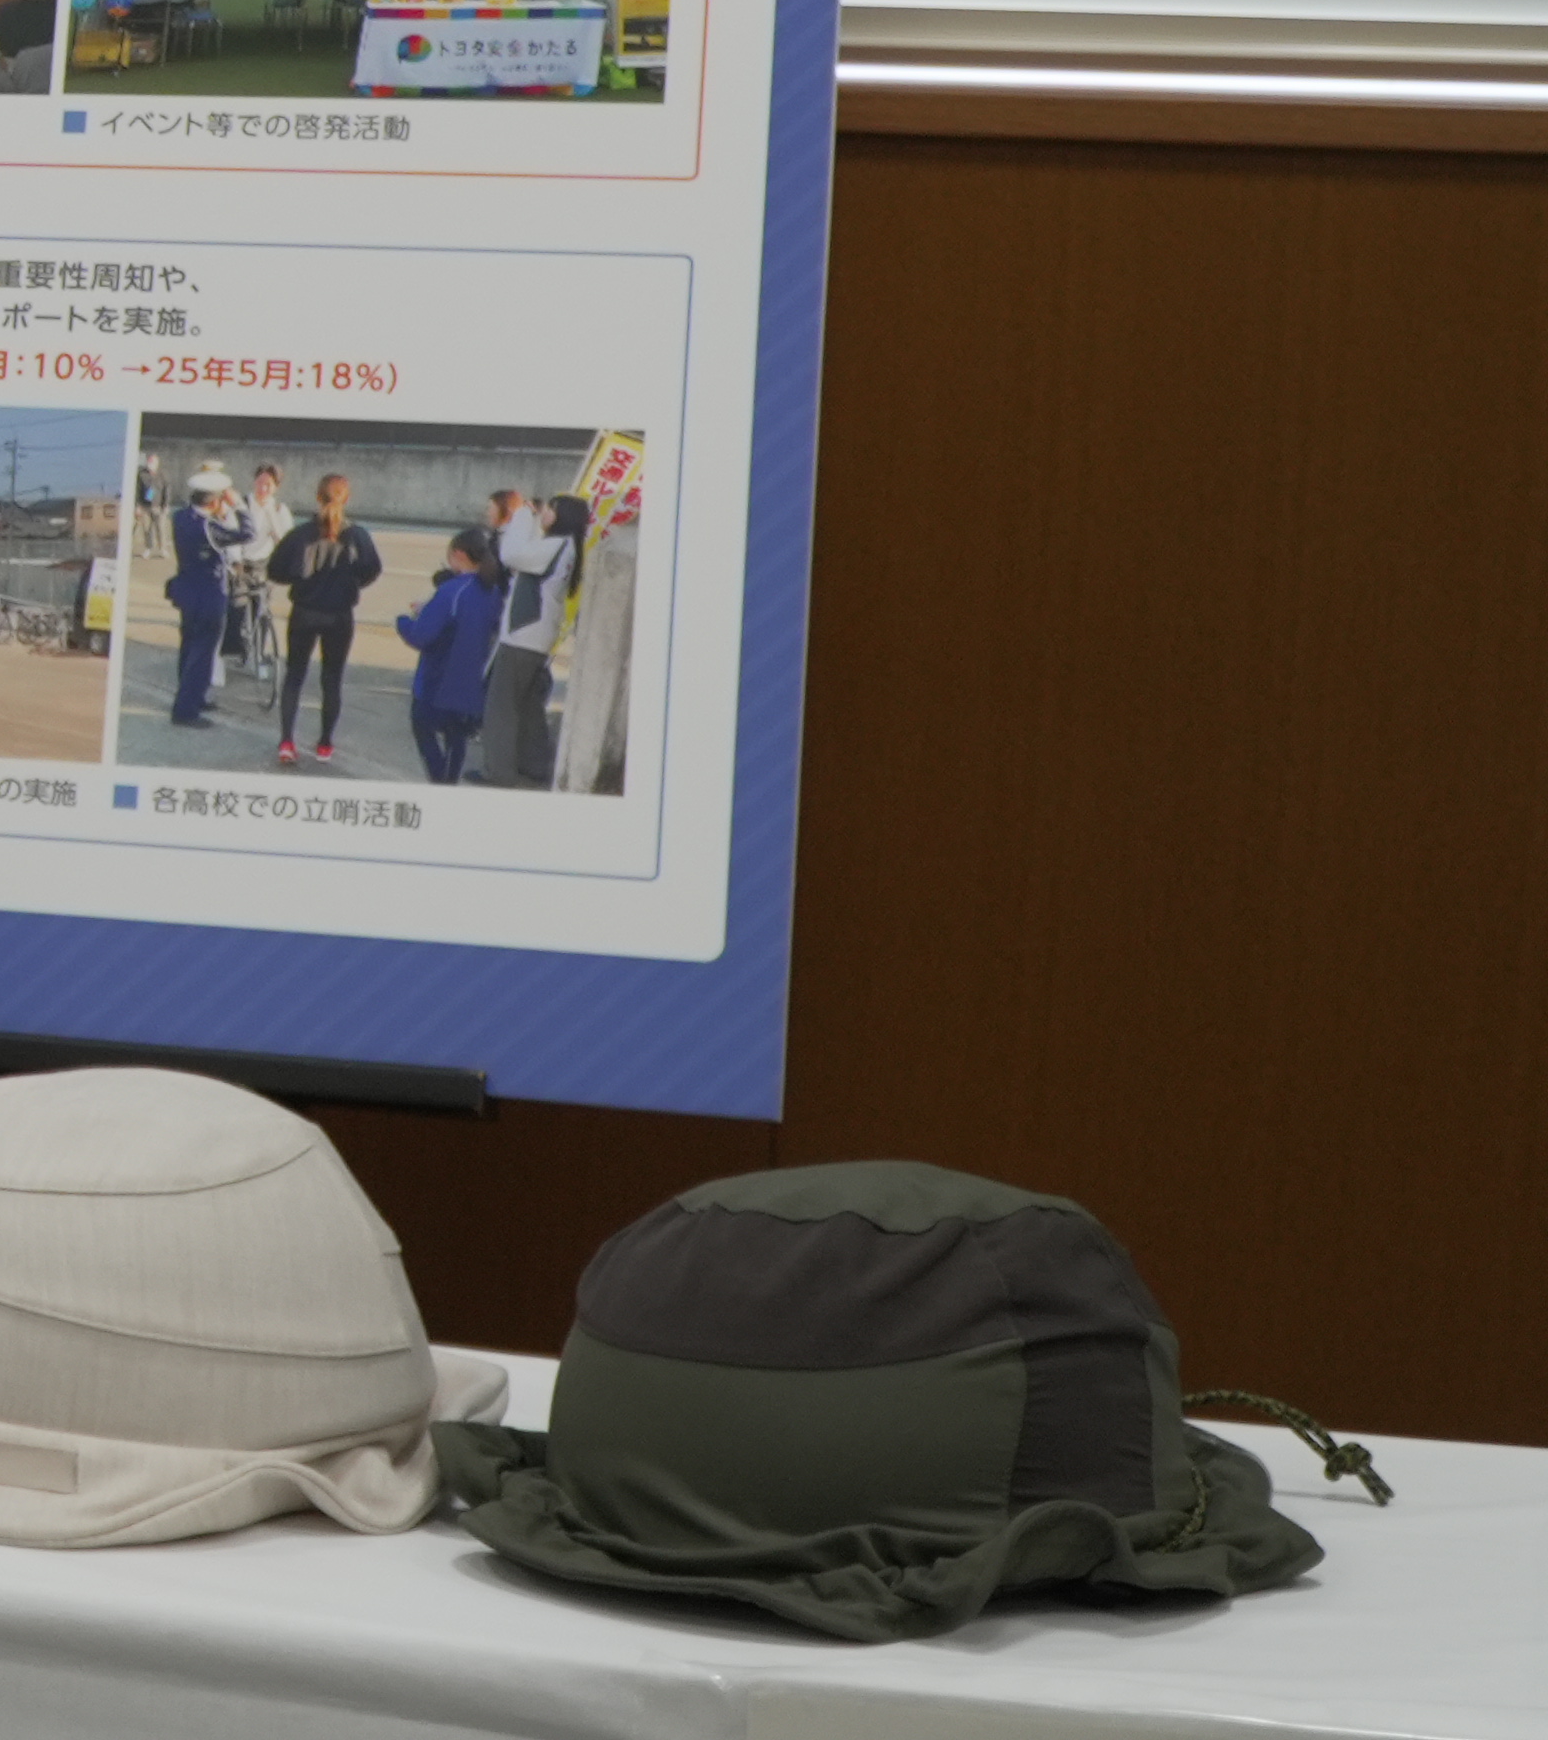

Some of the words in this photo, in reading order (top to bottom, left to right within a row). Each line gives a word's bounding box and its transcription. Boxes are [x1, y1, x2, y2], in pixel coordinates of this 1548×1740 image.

[99, 111, 411, 142] イベント等での啓発活動
[151, 785, 422, 830] 各高校での立哨活動
